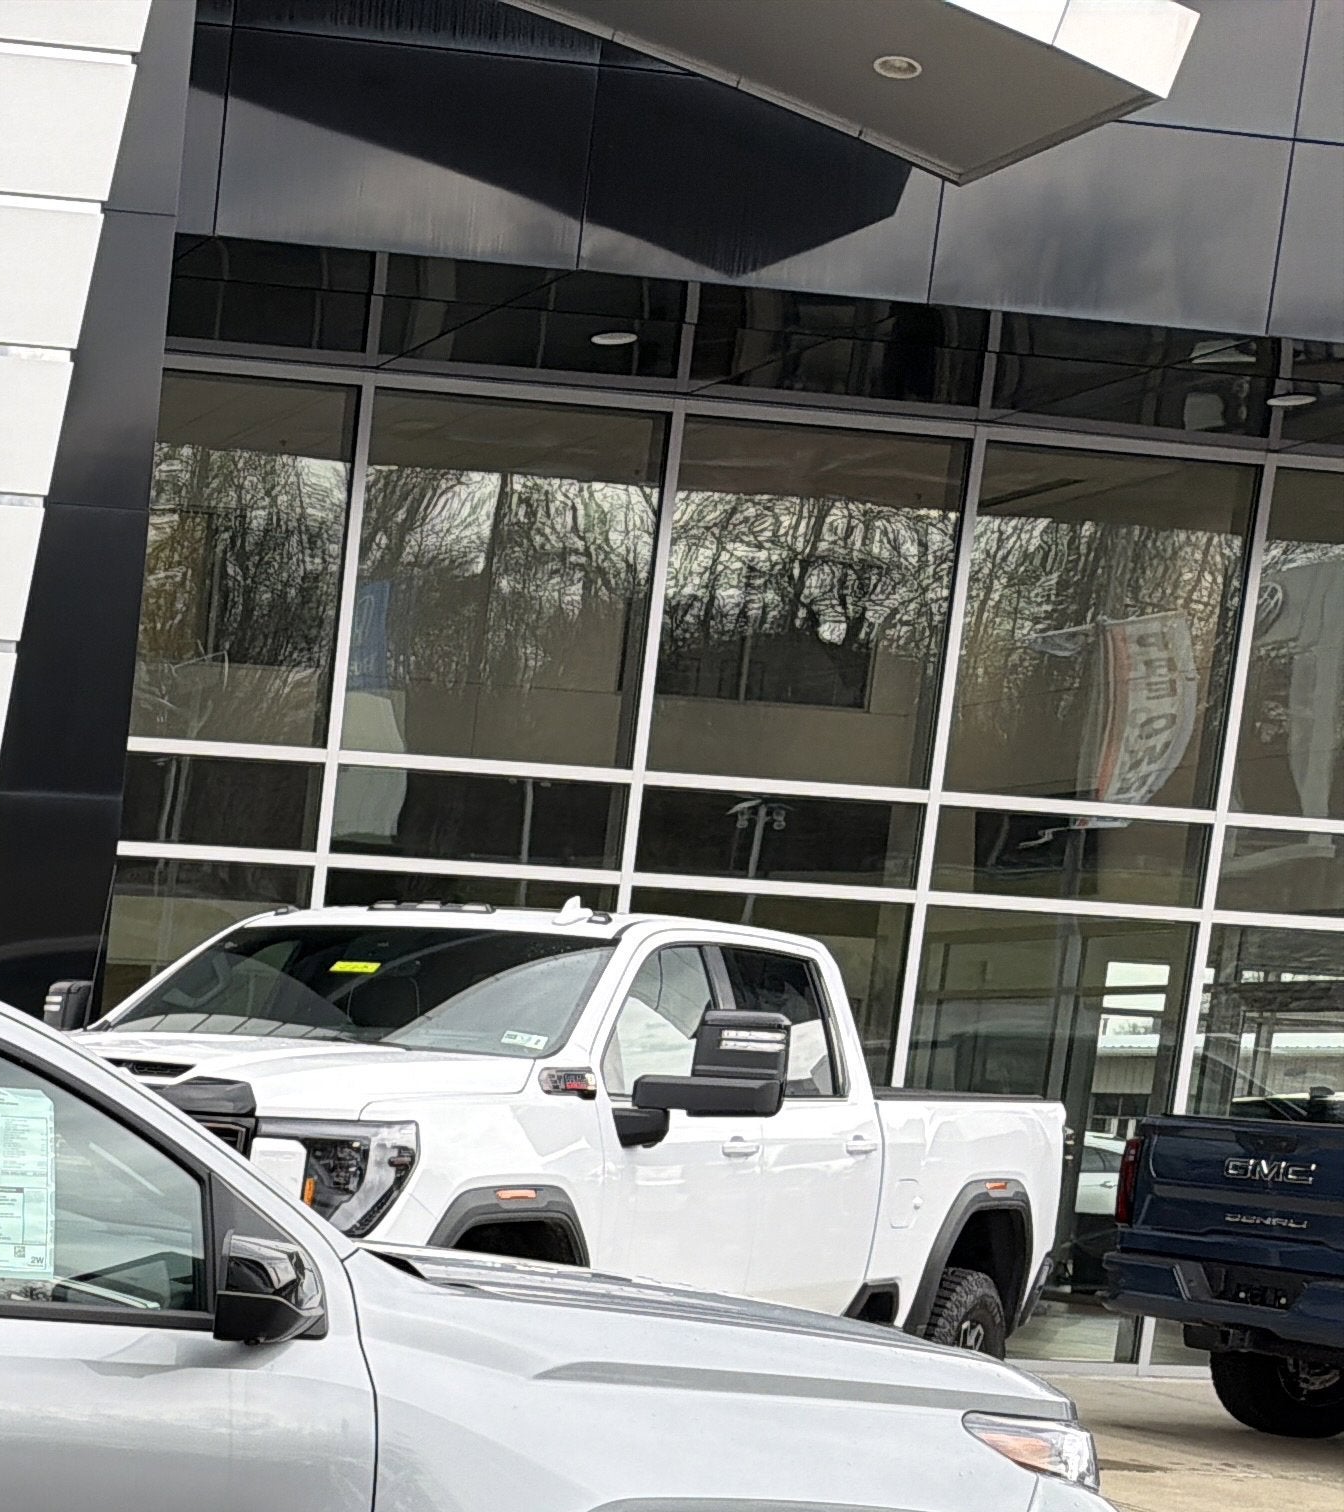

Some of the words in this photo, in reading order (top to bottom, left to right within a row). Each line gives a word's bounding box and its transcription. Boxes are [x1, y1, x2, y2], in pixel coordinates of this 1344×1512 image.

[1223, 1157, 1317, 1185] GMC
[1224, 1213, 1308, 1229] DENALI
[30, 1256, 44, 1264] 2W
